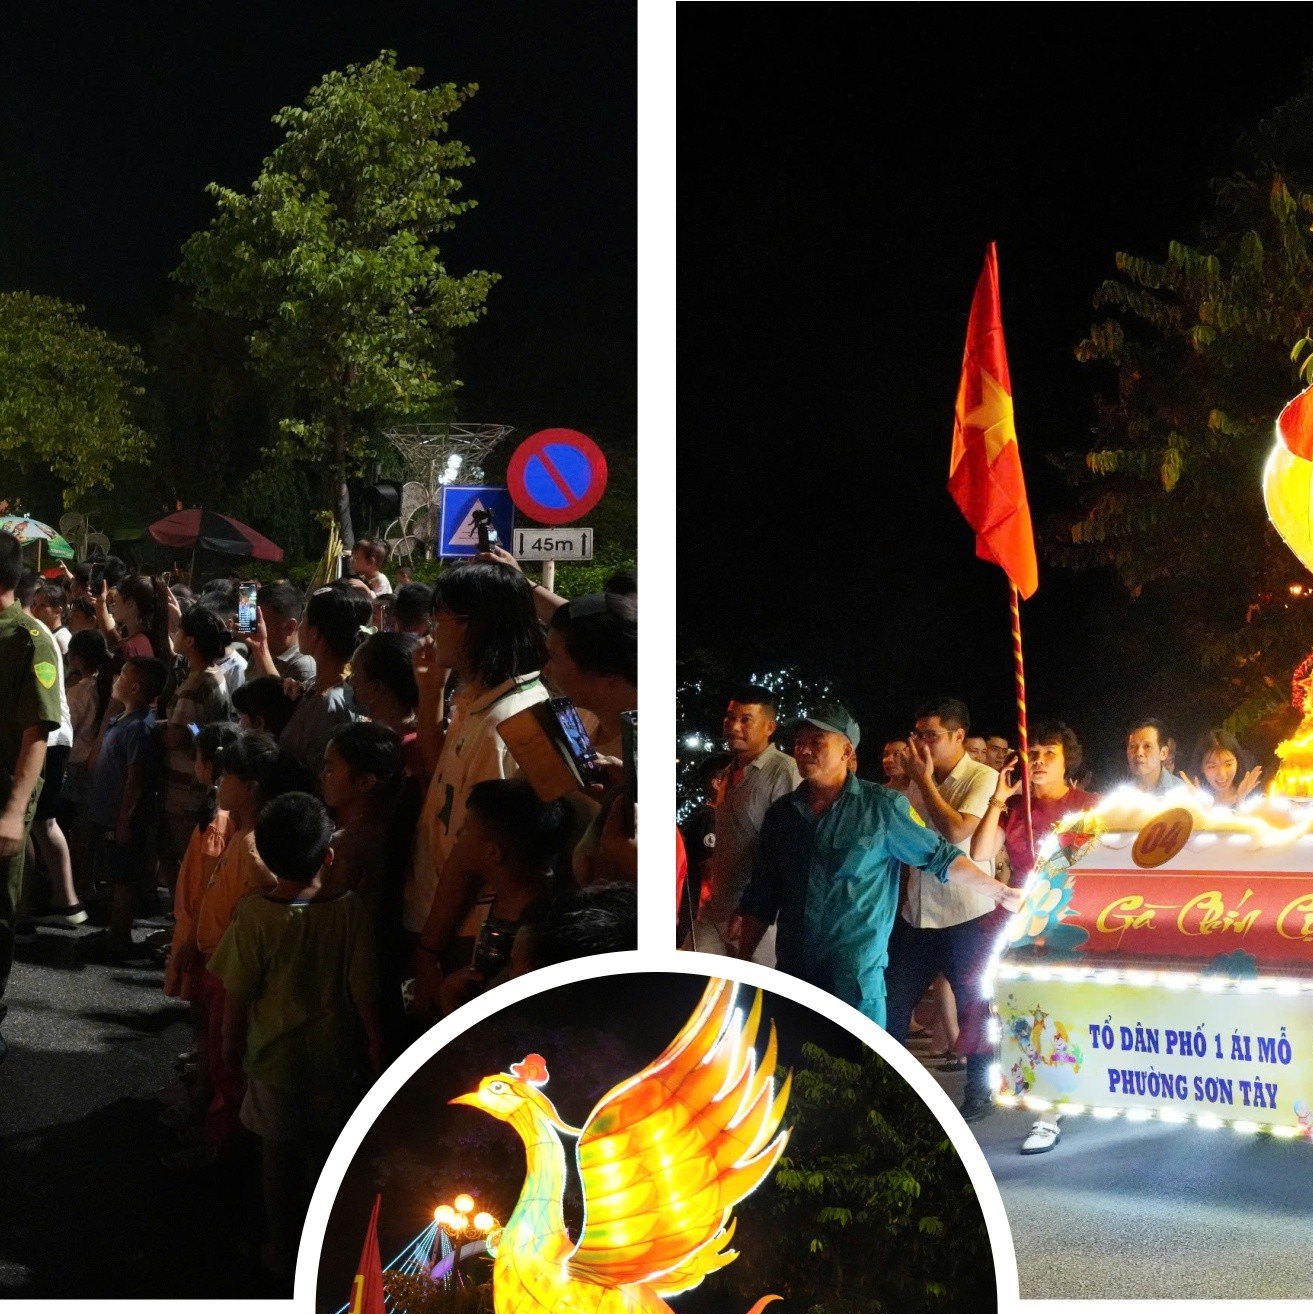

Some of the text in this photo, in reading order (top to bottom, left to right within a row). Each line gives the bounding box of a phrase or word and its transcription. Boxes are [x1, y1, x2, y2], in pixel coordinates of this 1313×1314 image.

[532, 538, 573, 551] 45m
[1140, 821, 1183, 854] 04
[1096, 895, 1178, 942] Gà
[1177, 889, 1262, 938] Chín
[1089, 1015, 1292, 1065] TỔ DÂN PHỐ 1 ÁI MỖ
[1107, 1066, 1278, 1109] PHƯỜNG SƠN TÂY
